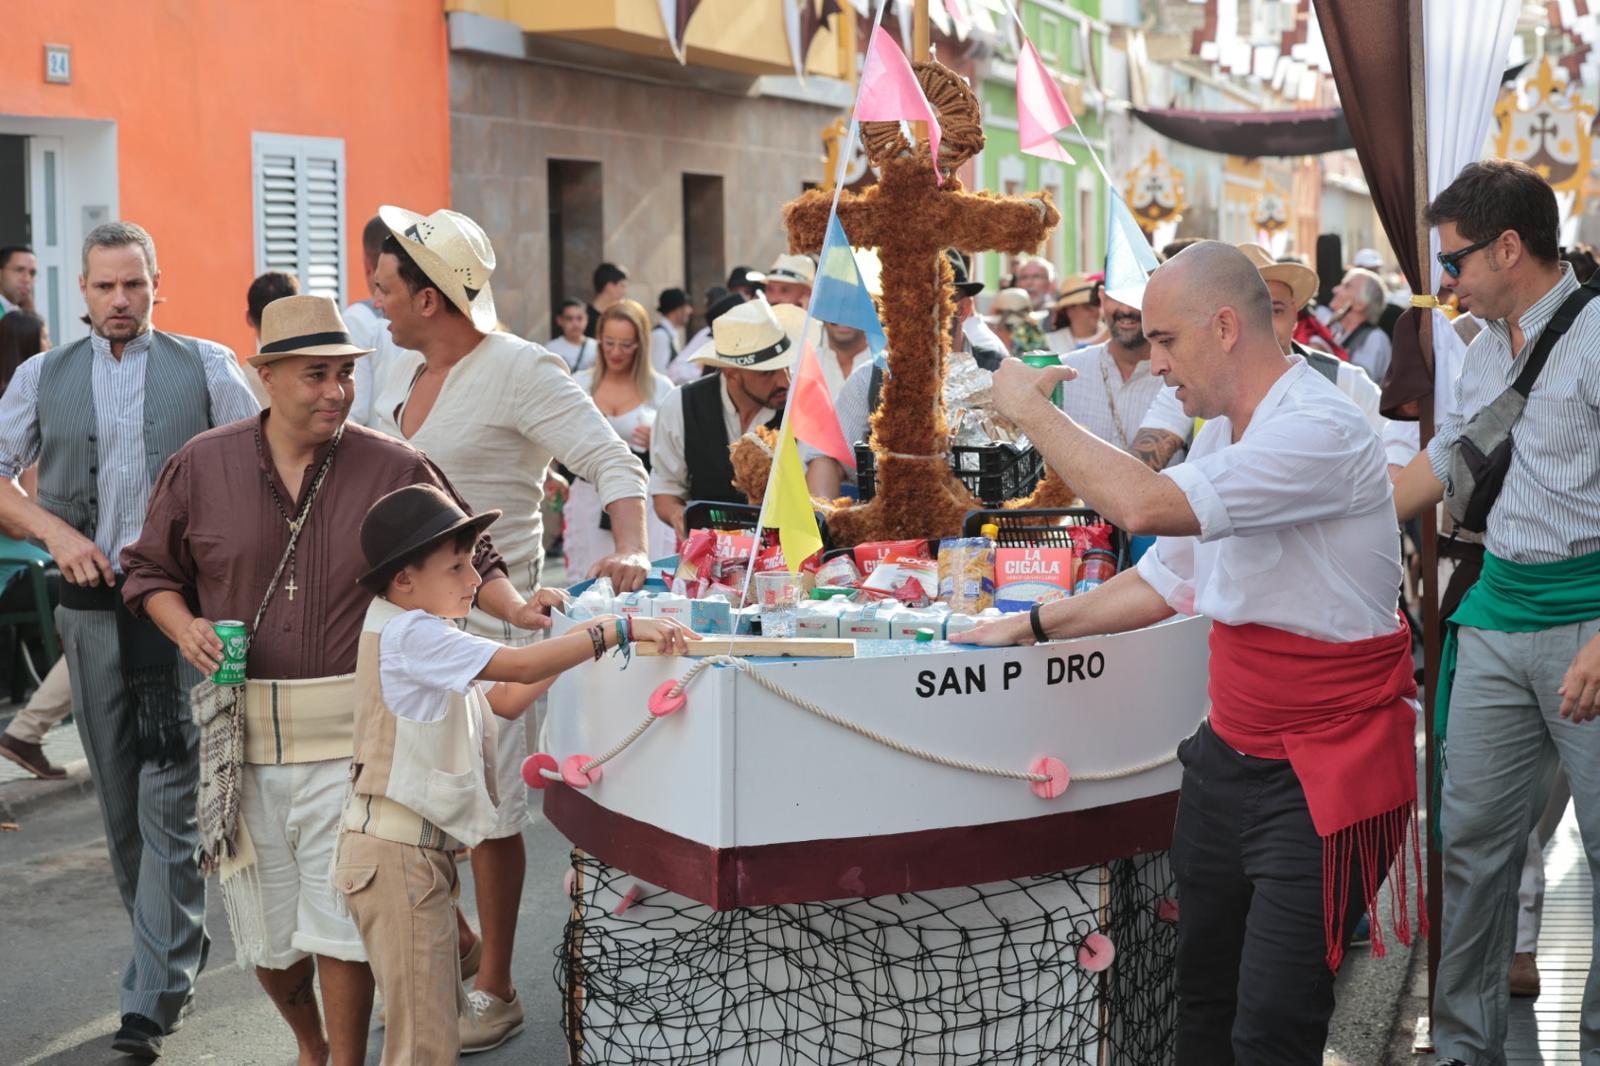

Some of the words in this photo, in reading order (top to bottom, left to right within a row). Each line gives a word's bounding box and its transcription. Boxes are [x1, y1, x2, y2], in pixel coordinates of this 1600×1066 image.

[1024, 549, 1041, 560] LA
[1004, 560, 1060, 574] CIGALA
[915, 664, 986, 698] SAN
